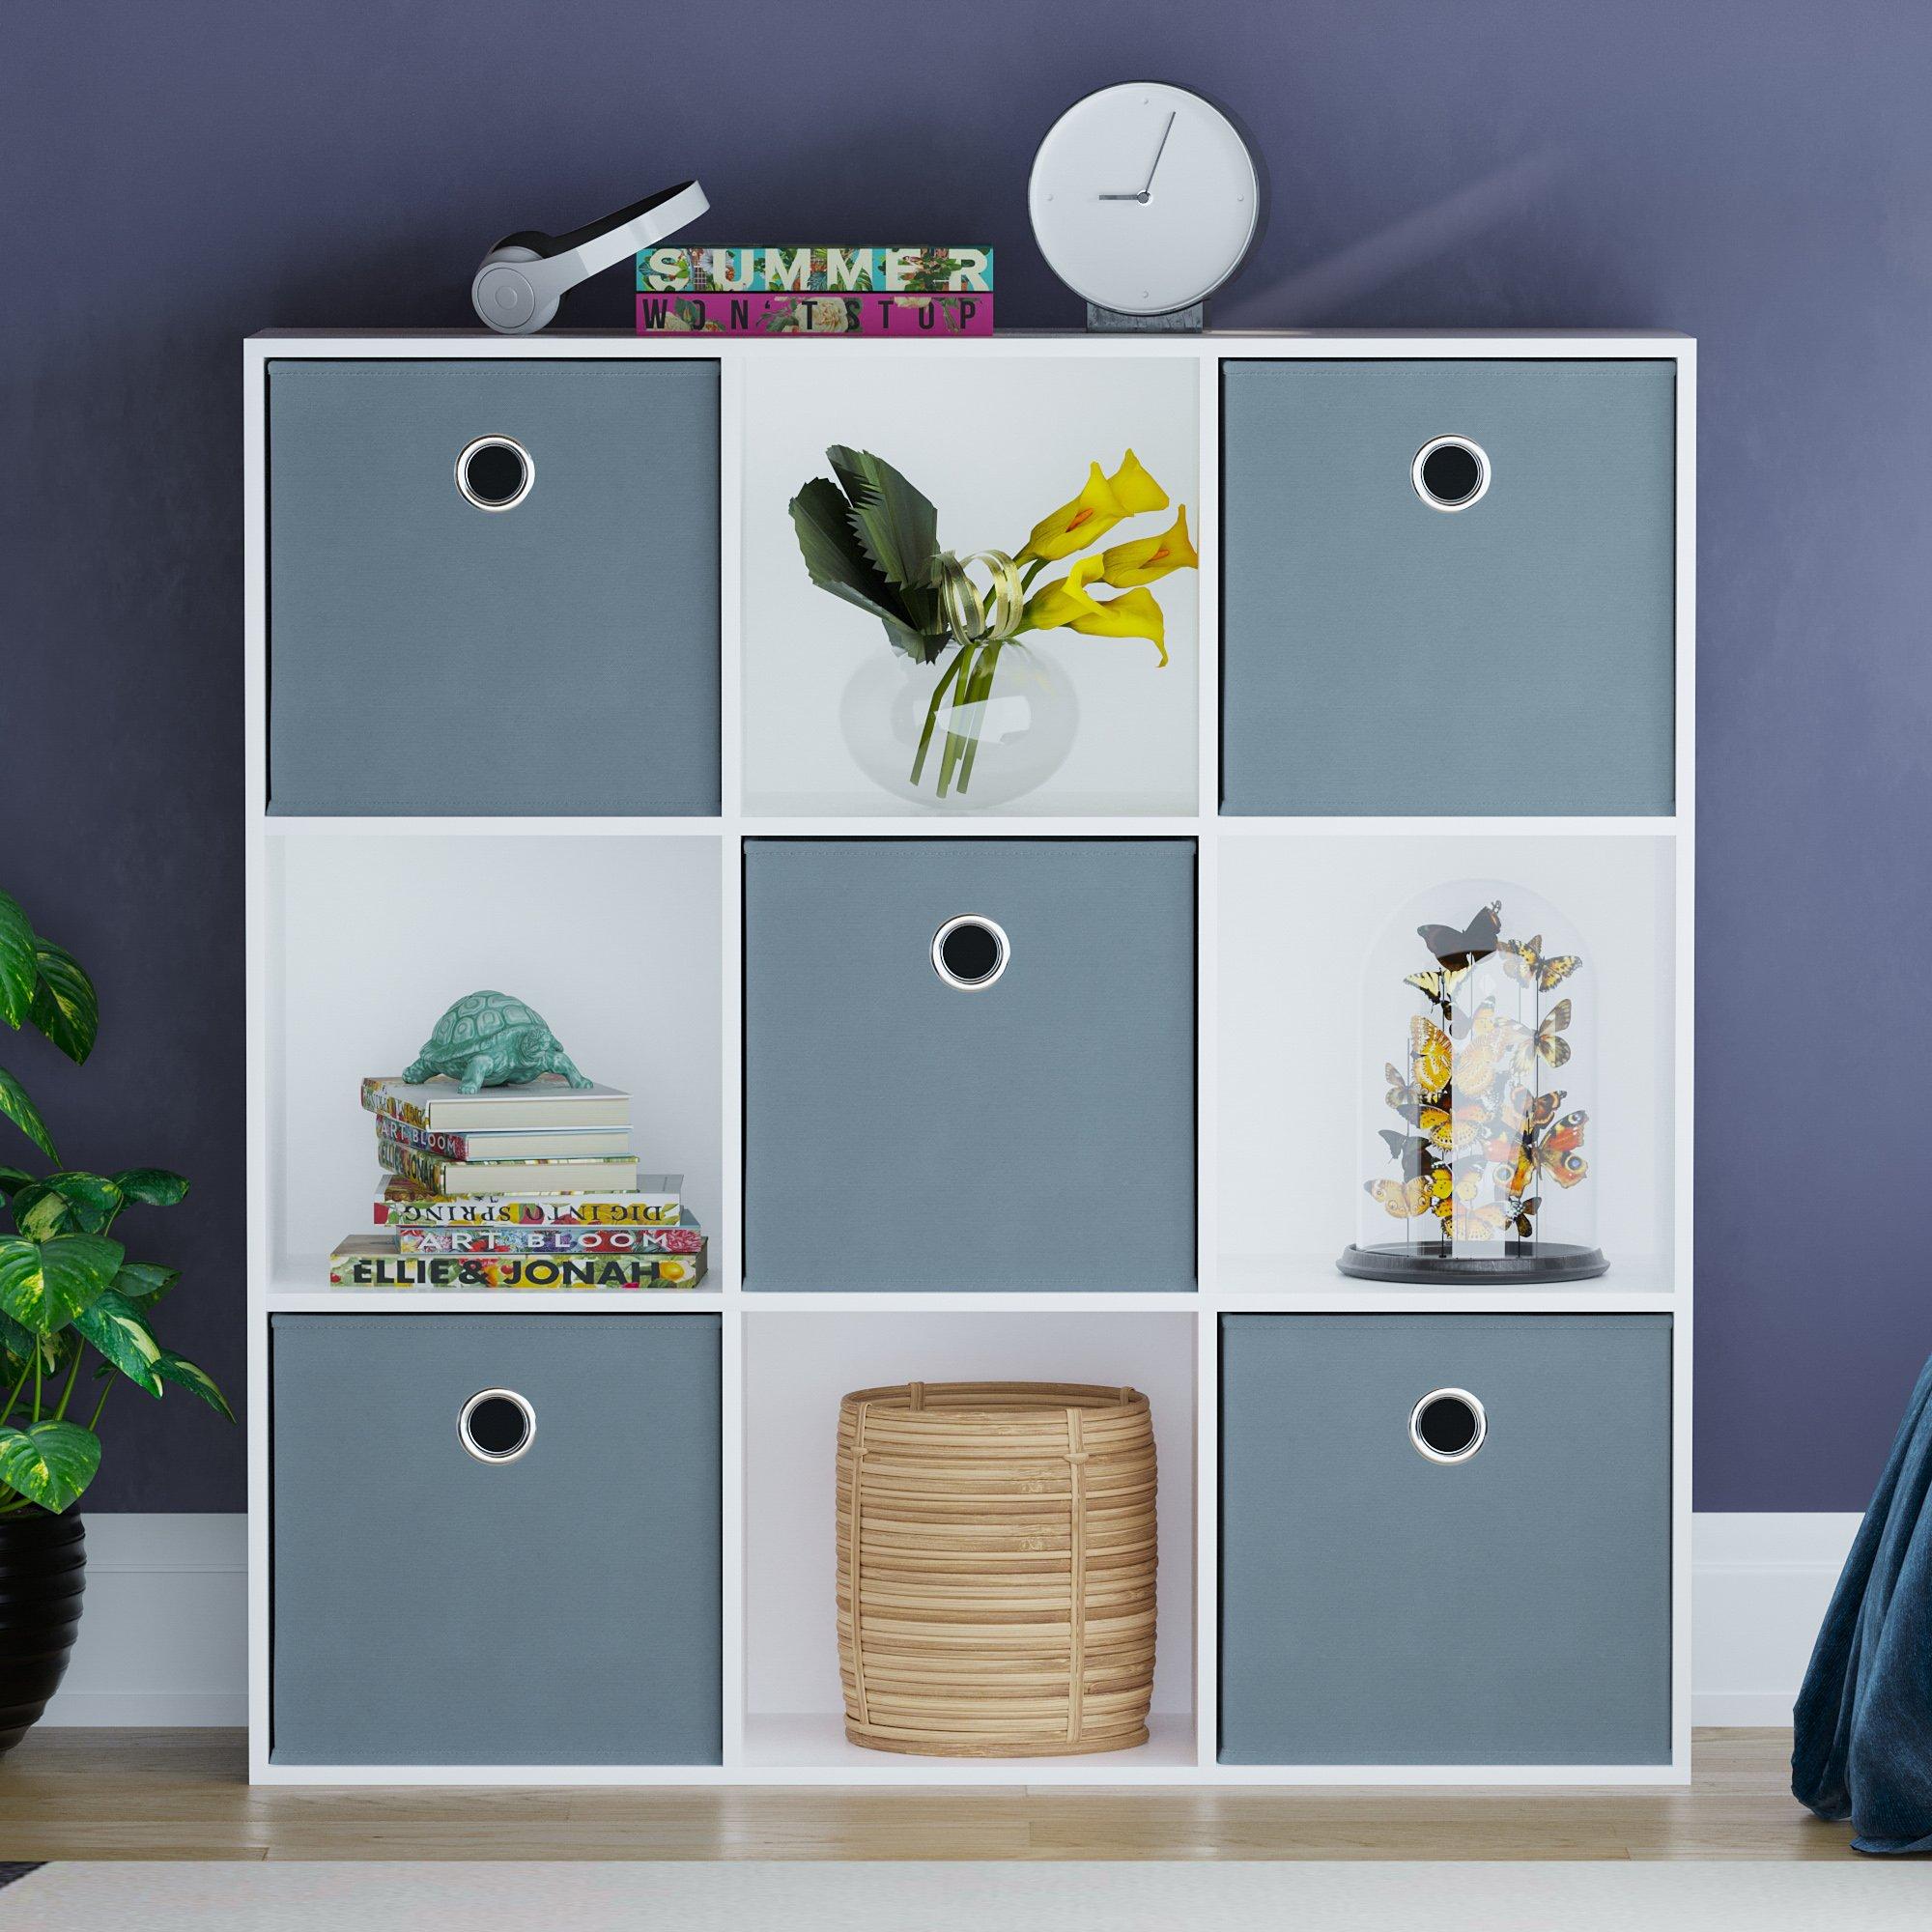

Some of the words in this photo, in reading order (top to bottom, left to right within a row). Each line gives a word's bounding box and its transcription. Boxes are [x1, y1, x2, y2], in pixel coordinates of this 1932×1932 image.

[647, 248, 990, 292] SUMMER
[381, 1122, 406, 1141] ART
[412, 1128, 456, 1156] BLOOM
[402, 1205, 511, 1221] SPRING
[526, 1205, 600, 1221] INTO
[611, 1205, 663, 1221] DIG
[417, 1232, 498, 1250] ART
[526, 1232, 668, 1250] BLOOM
[502, 1259, 661, 1285] JONAH
